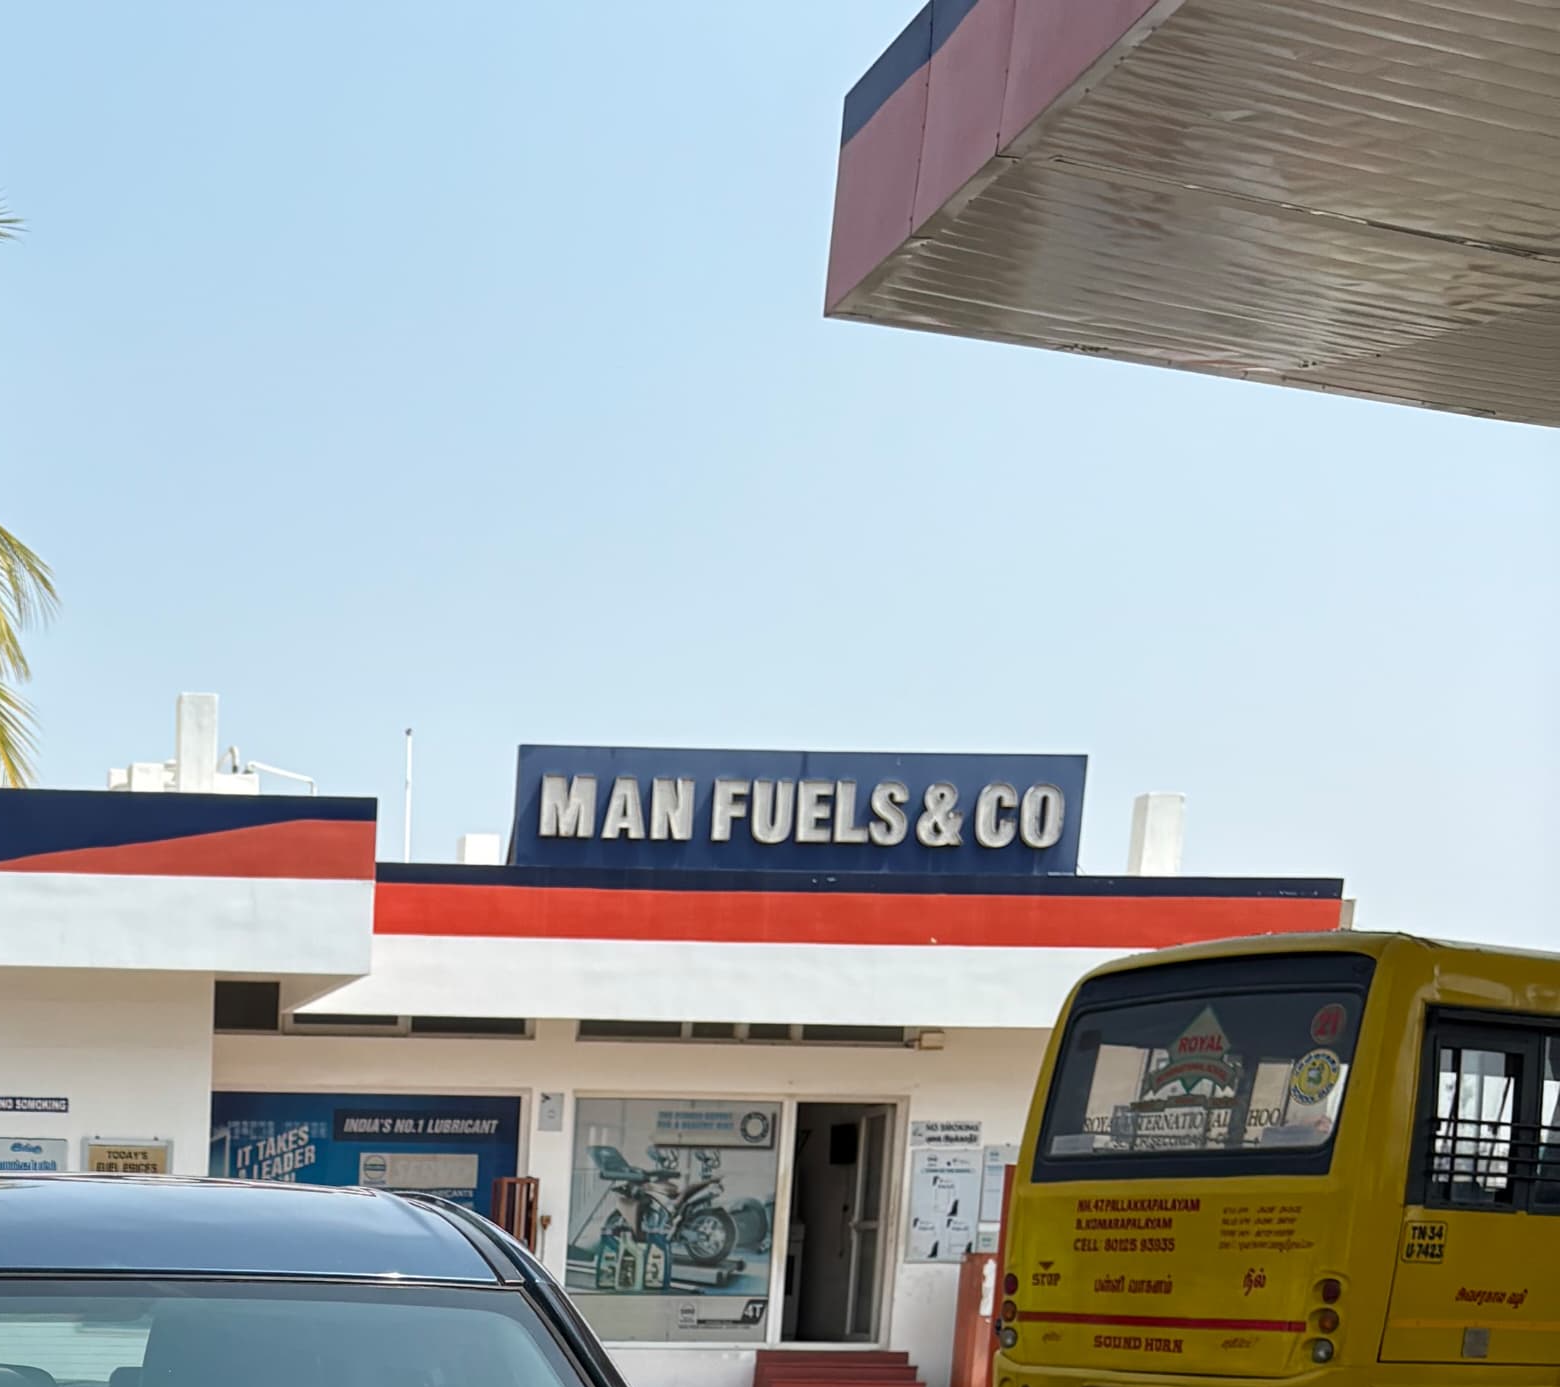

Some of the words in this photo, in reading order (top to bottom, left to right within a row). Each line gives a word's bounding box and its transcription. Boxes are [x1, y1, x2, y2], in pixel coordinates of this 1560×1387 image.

[538, 774, 695, 841] MAN
[1313, 1013, 1339, 1036] 21
[1177, 1034, 1224, 1054] ROYAL
[344, 1118, 392, 1133] INDIA'S
[394, 1118, 424, 1134] NO.1
[426, 1119, 499, 1135] LUBRICANT
[106, 1150, 148, 1160] TODAY'S
[237, 1144, 253, 1169] IT
[256, 1125, 309, 1161] TAKES
[1031, 1273, 1061, 1286] STOP
[1243, 1267, 1267, 1297] நில்
[1093, 1335, 1142, 1350] SOUND
[1143, 1337, 1184, 1353] HORN
